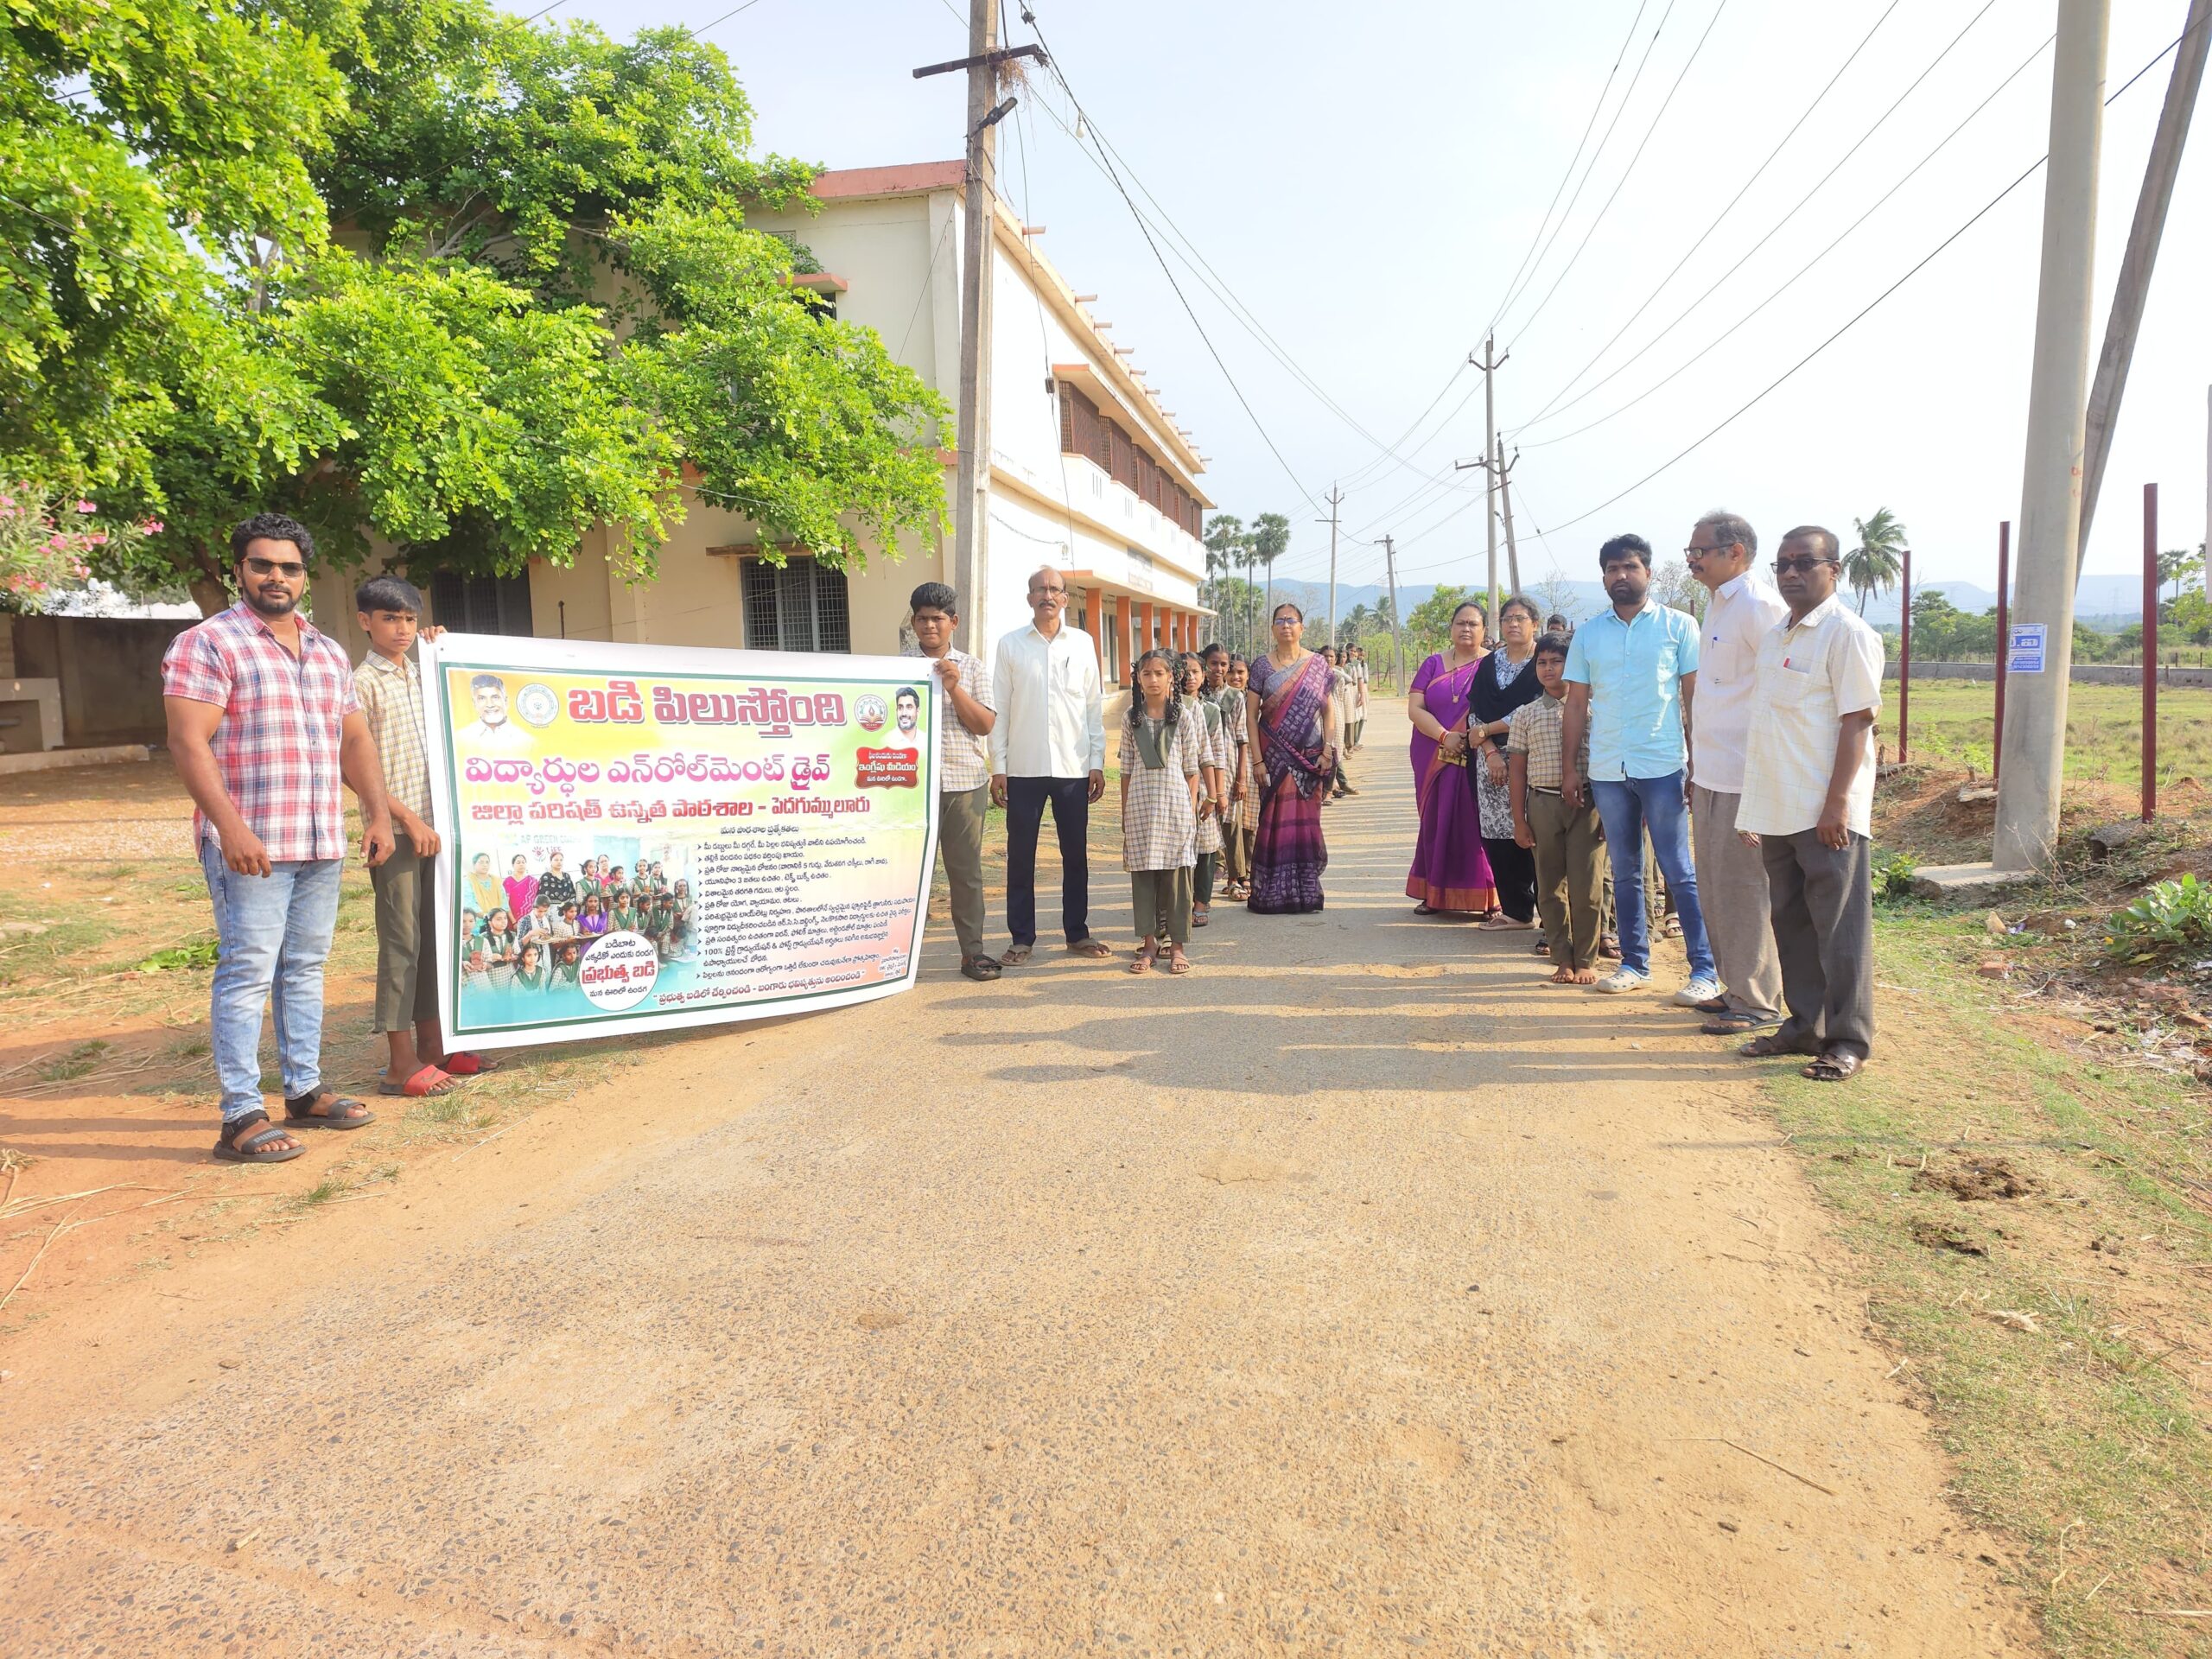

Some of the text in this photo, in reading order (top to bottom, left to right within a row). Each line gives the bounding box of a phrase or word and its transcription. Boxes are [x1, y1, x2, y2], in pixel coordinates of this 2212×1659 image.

[569, 680, 645, 724] బడి
[652, 686, 847, 739] పిలుస్తోంది
[859, 760, 916, 772] ఇంగ్లీషు మీడియం
[791, 753, 830, 791] డ్రైవ్
[471, 804, 523, 825] జిల్లా
[529, 799, 602, 821] పరిషత్
[608, 799, 667, 823] ఉన్నత
[672, 798, 753, 817] పాఠశాల
[772, 796, 870, 818] పెదగుమ్ములూరు
[713, 844, 731, 853] డబ్బులు
[733, 841, 741, 849] మీ
[704, 854, 718, 862] తల్లికి
[704, 866, 715, 875] ప్రతి
[705, 888, 733, 898] విశాలమైన
[704, 900, 715, 910] ప్రతి
[704, 925, 725, 934] పూర్తిగా
[605, 938, 636, 948] బడిబాట
[705, 937, 715, 946] ప్రతి
[717, 935, 747, 944] సంవత్సరం
[585, 950, 609, 963] ఎక్కడికో
[610, 950, 634, 959] ఎందుకు
[582, 961, 655, 984] ప్రభుత్వ బడి
[702, 970, 724, 979] పిల్లలను
[605, 986, 626, 995] ఊరిలో
[659, 994, 684, 1005] ప్రభుత్వ
[686, 988, 710, 999] బడిలో
[712, 984, 751, 998] చేర్పించండి
[758, 982, 786, 992] బంగారు
[825, 971, 861, 983] అందించండి
